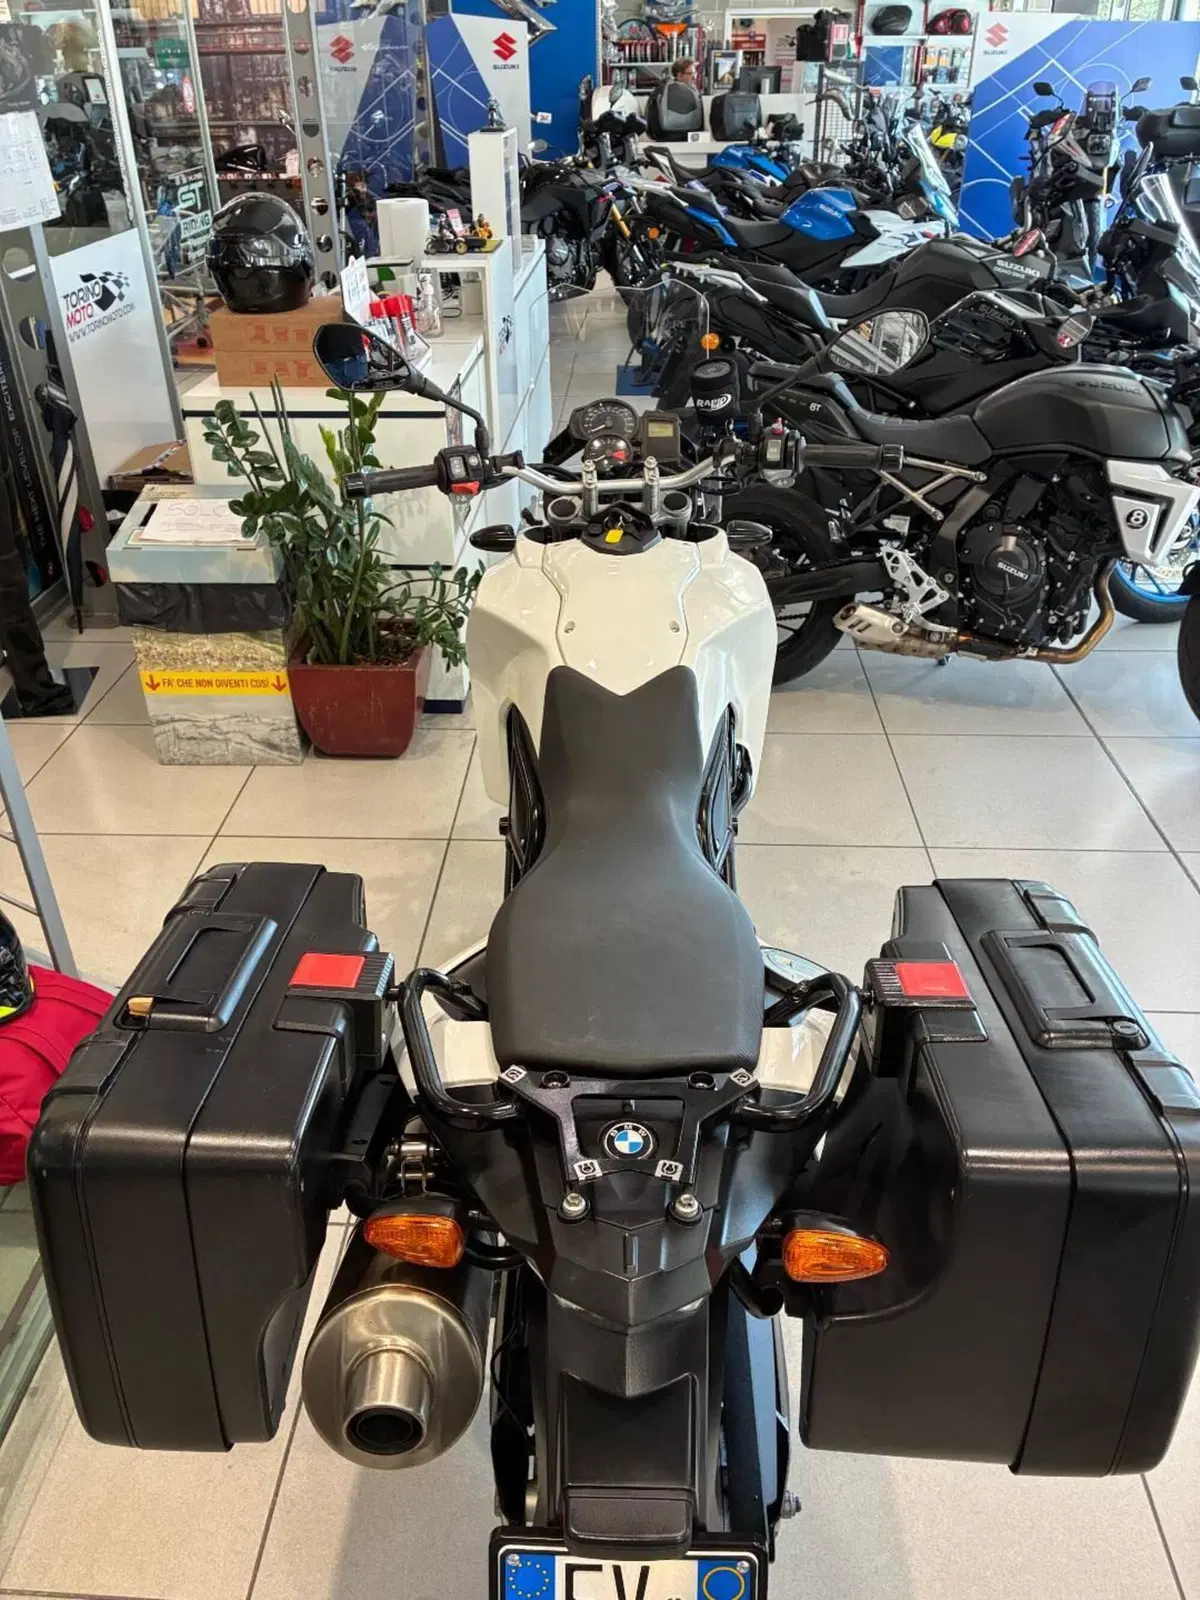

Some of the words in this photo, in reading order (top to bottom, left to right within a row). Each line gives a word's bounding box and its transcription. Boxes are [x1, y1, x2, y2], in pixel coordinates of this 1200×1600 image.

[996, 259, 1041, 278] SUZUKI
[62, 280, 101, 312] TORINO
[66, 303, 94, 330] MOTO
[18, 446, 32, 487] LEVEL
[1131, 510, 1145, 525] 8
[997, 561, 1029, 580] SUZUKI
[162, 678, 174, 688] FA'
[176, 678, 193, 688] CHE
[195, 678, 214, 688] NON
[216, 678, 249, 689] DIVENTI
[609, 1124, 648, 1138] BMW
